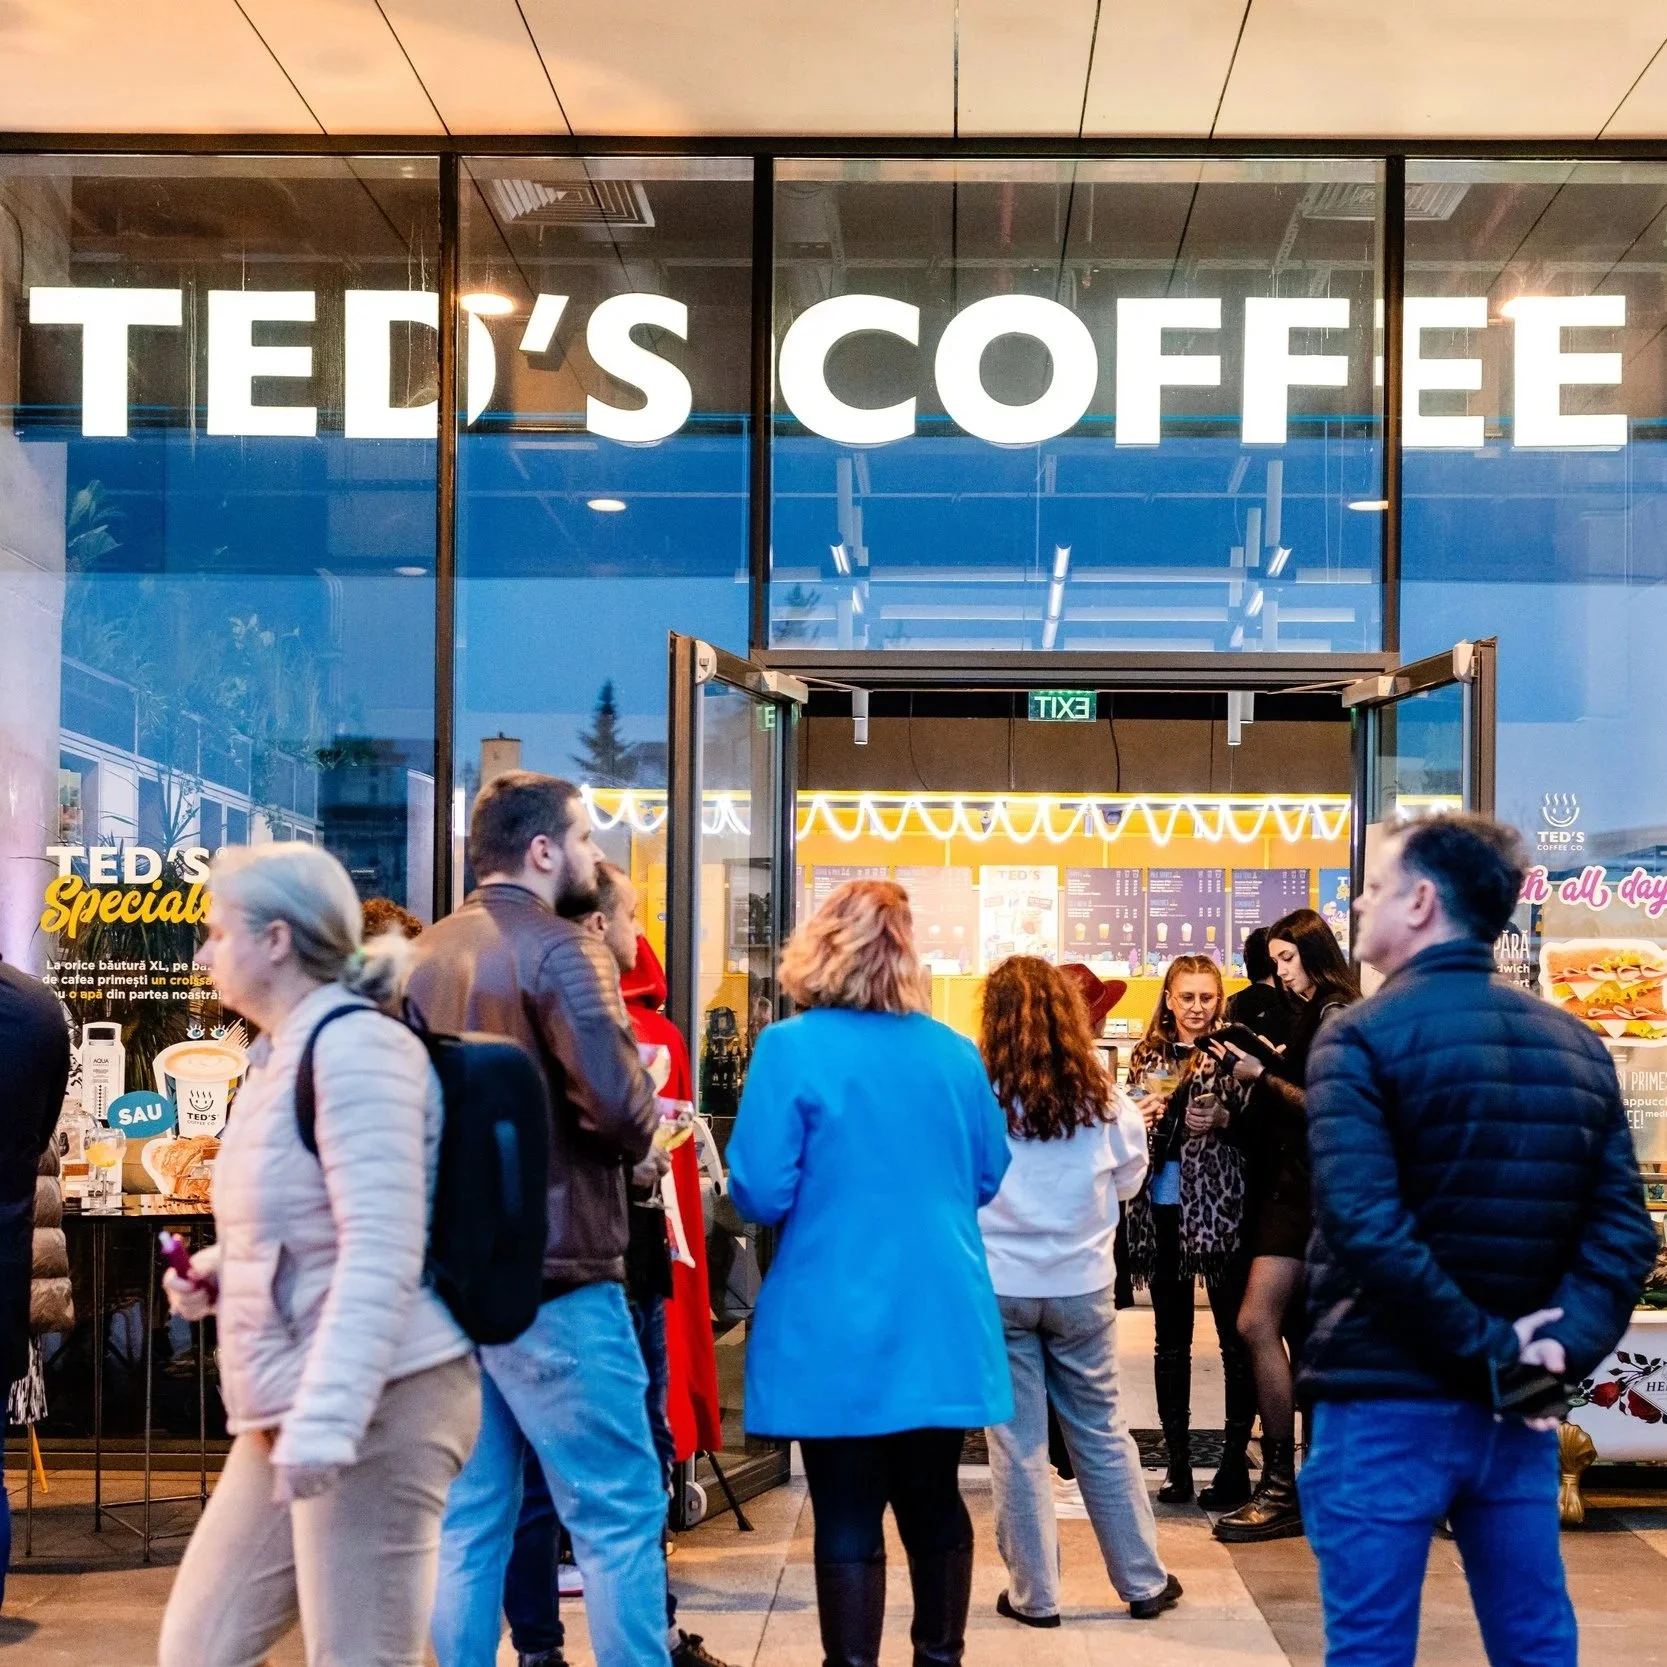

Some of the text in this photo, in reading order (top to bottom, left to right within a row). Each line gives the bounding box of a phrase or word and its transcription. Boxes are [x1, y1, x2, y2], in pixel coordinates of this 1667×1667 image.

[29, 288, 1627, 447] TED'S COFFEE
[1537, 831, 1585, 843] TED'S
[46, 846, 210, 884] TED'S
[996, 869, 1041, 881] TED'S
[1562, 868, 1609, 908] all
[46, 961, 61, 971] La
[65, 960, 96, 971] orice
[99, 960, 146, 971] băutură
[149, 961, 170, 973] XL,
[172, 963, 188, 973] pe
[42, 975, 58, 985] de
[61, 975, 94, 985] cafea
[97, 975, 148, 988] primești
[151, 977, 167, 985] un
[69, 991, 78, 1000] o
[80, 990, 103, 1001] apă
[106, 990, 126, 1000] din
[129, 990, 168, 1001] partea
[1631, 1071, 1667, 1091] PRIME
[118, 1103, 162, 1126] SAU
[186, 1112, 217, 1121] TED'S
